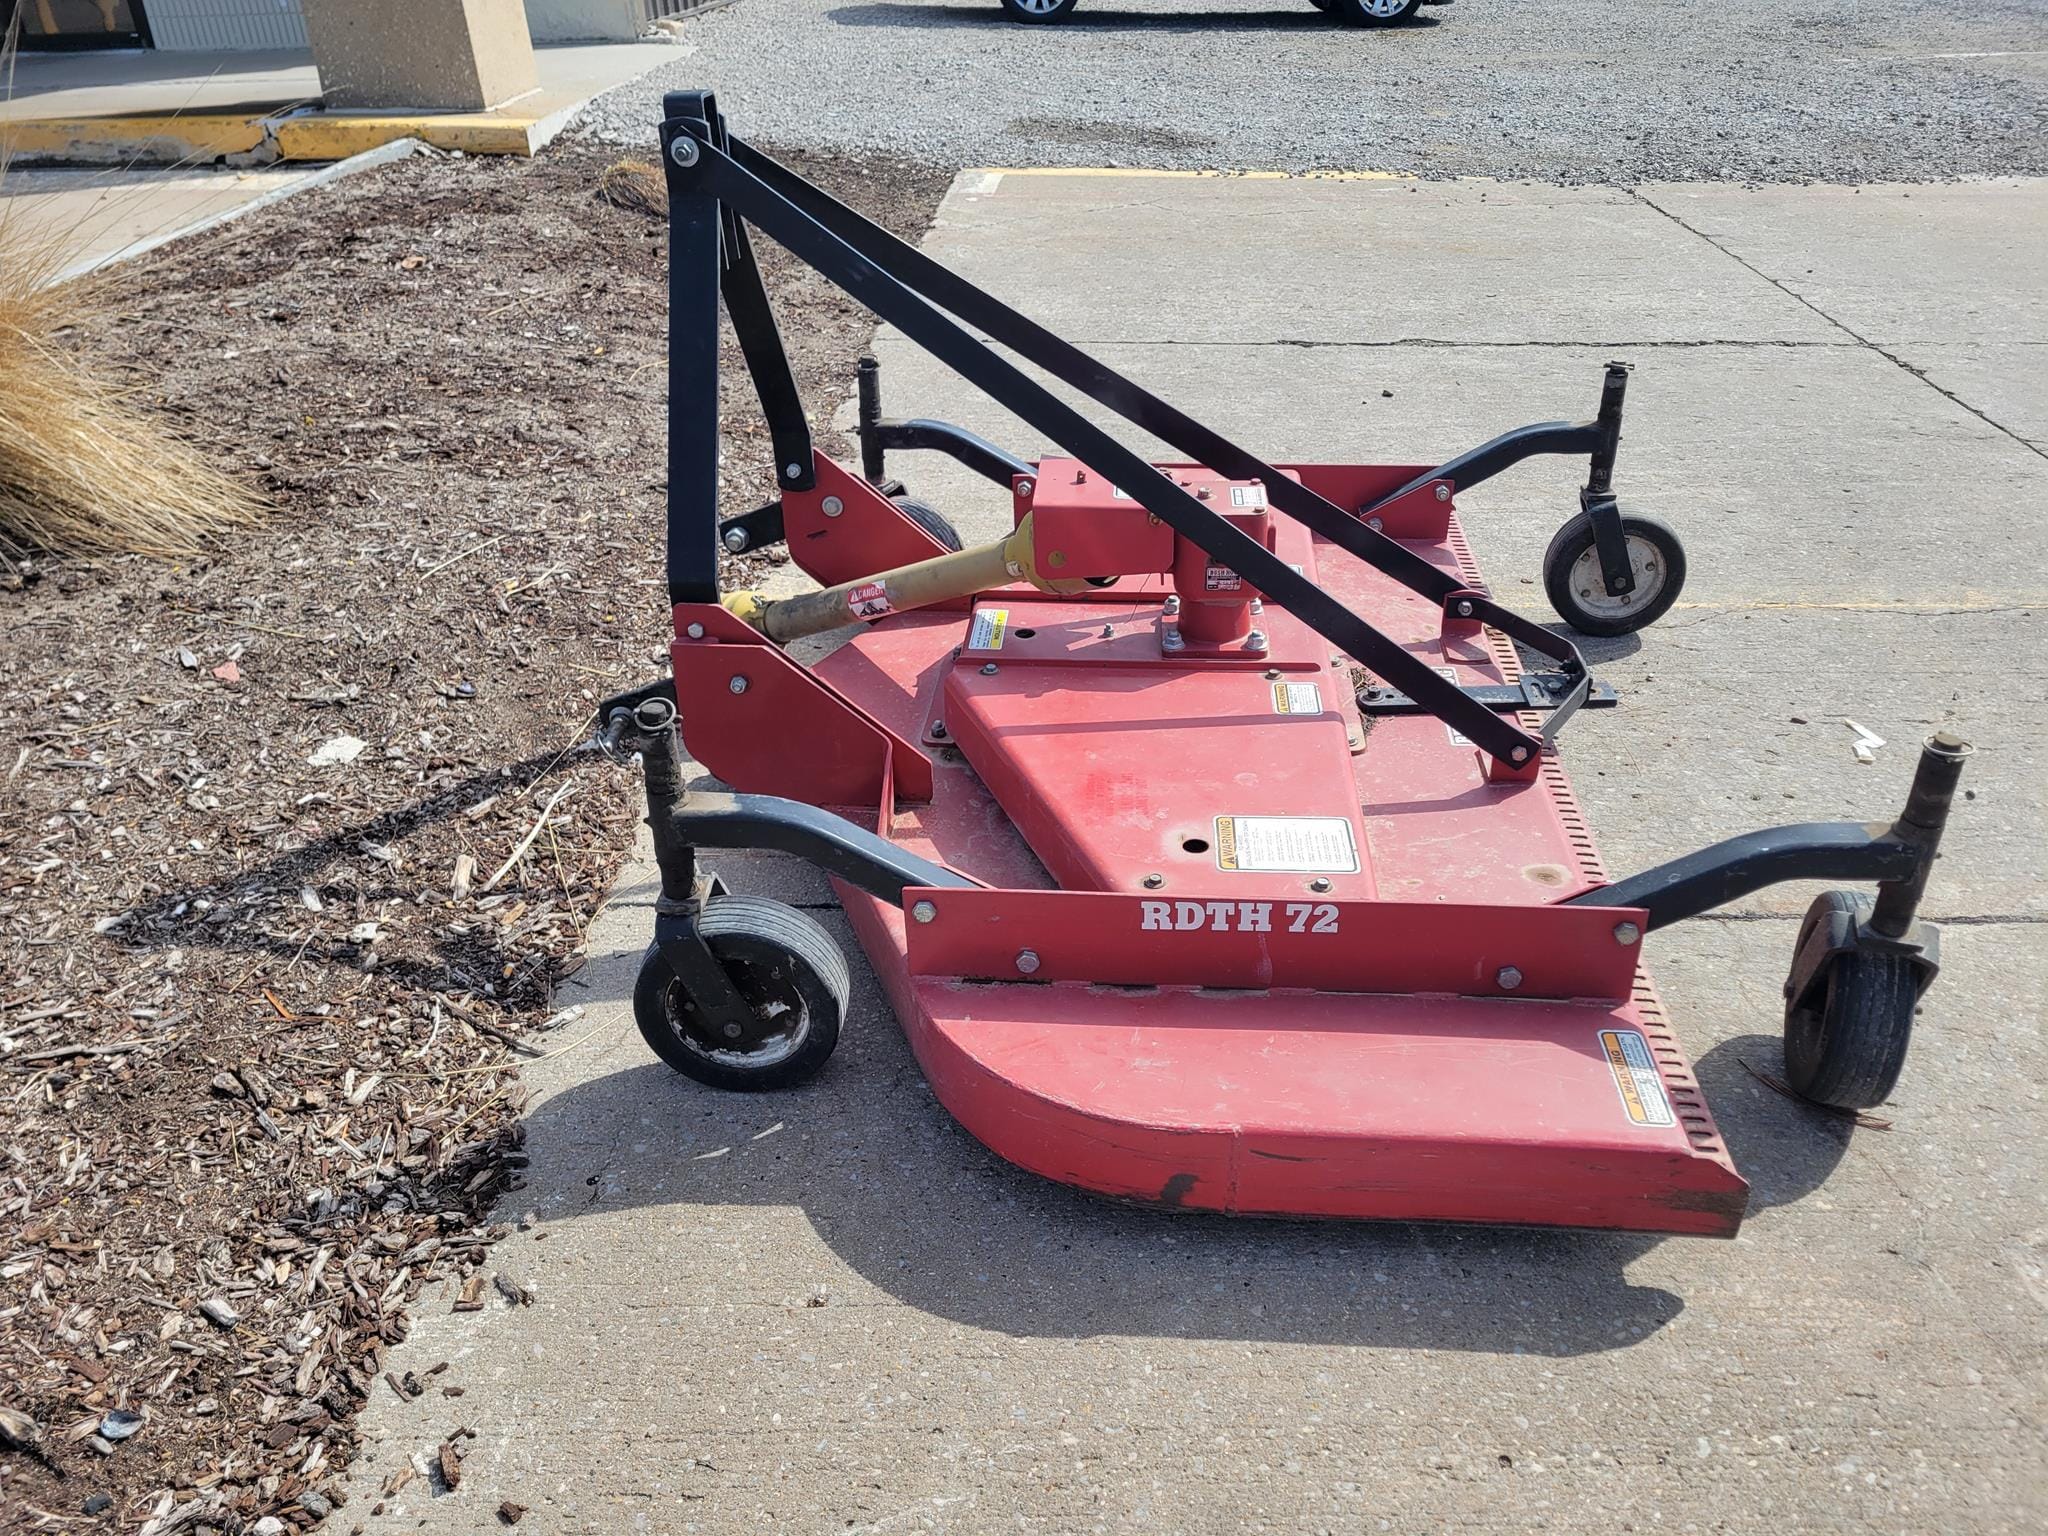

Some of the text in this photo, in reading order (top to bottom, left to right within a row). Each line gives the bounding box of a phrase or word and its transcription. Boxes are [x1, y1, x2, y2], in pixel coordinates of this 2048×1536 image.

[1219, 820, 1234, 857] WARNING
[1140, 901, 1340, 934] RDTH 72
